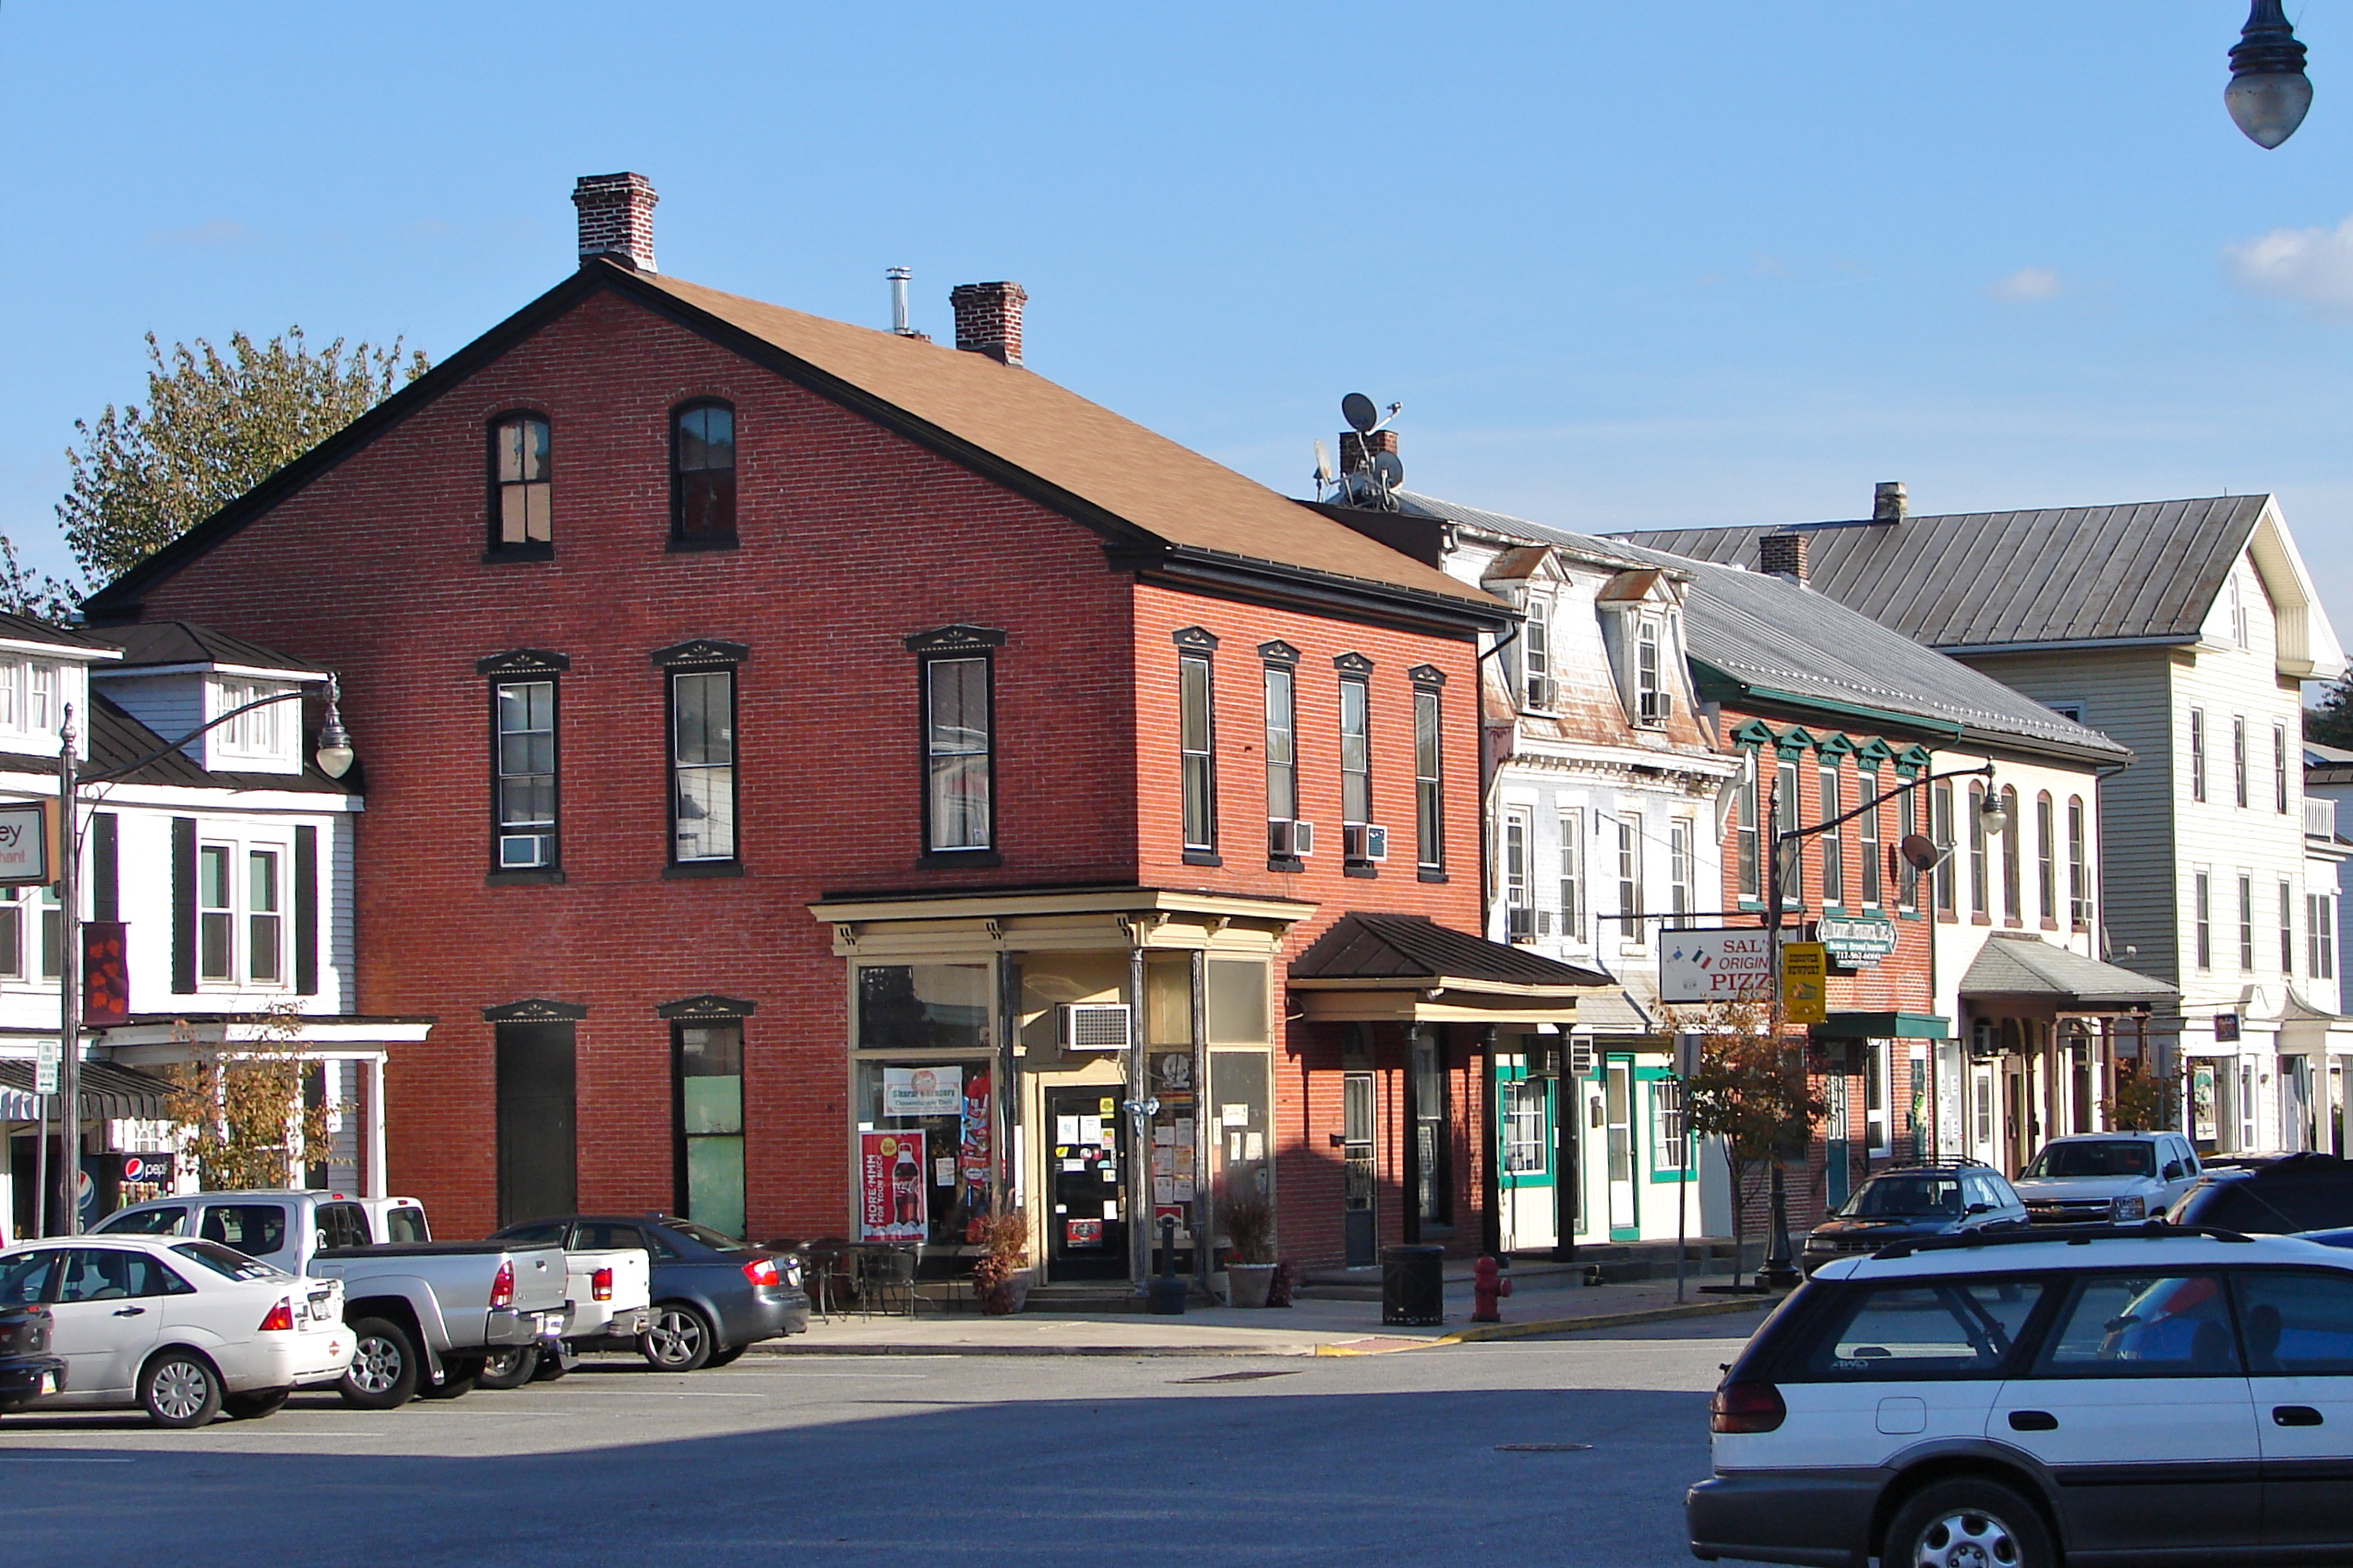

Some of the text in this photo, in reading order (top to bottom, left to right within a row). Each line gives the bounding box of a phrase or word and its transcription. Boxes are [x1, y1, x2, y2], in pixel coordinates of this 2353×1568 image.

[1723, 940, 1770, 953] SAL'
[1719, 957, 1770, 970] ORIGIN
[1787, 965, 1820, 976] NEWPORT
[1711, 974, 1770, 991] PIZZ
